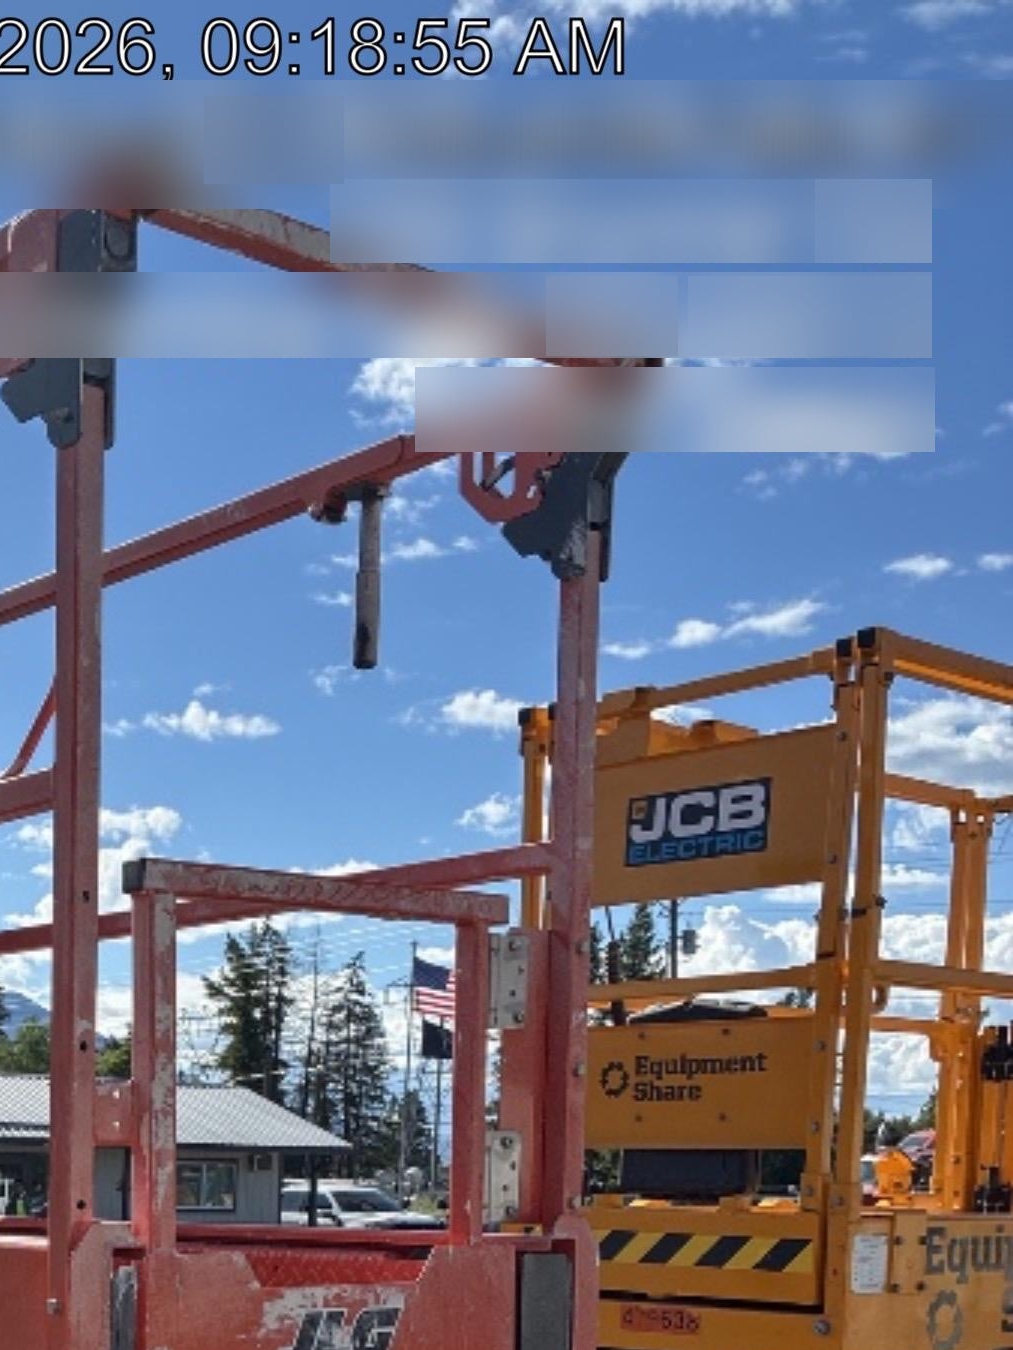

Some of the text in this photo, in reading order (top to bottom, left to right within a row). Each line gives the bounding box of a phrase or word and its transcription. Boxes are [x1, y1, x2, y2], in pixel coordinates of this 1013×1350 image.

[629, 783, 765, 843] JCB
[629, 829, 764, 865] ELECTRIC
[635, 1052, 768, 1080] Equipment
[634, 1081, 702, 1101] Share
